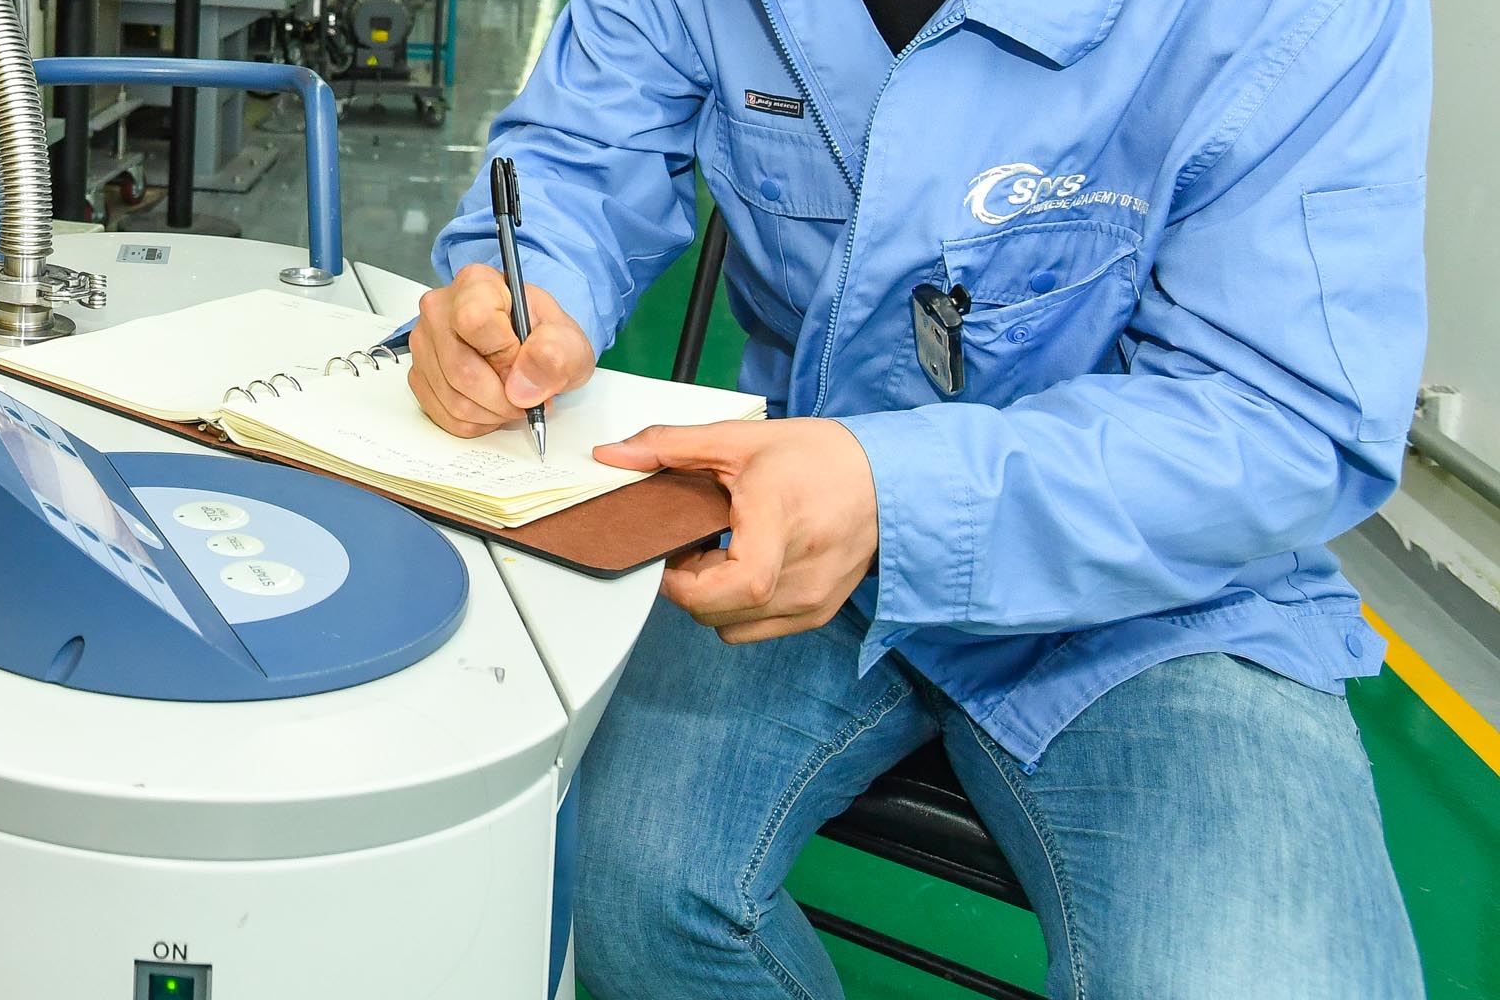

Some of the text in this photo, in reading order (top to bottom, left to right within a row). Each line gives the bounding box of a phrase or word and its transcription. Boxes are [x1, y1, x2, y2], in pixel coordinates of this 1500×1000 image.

[201, 505, 222, 521] STOP
[248, 563, 276, 587] START
[153, 941, 187, 960] ON
